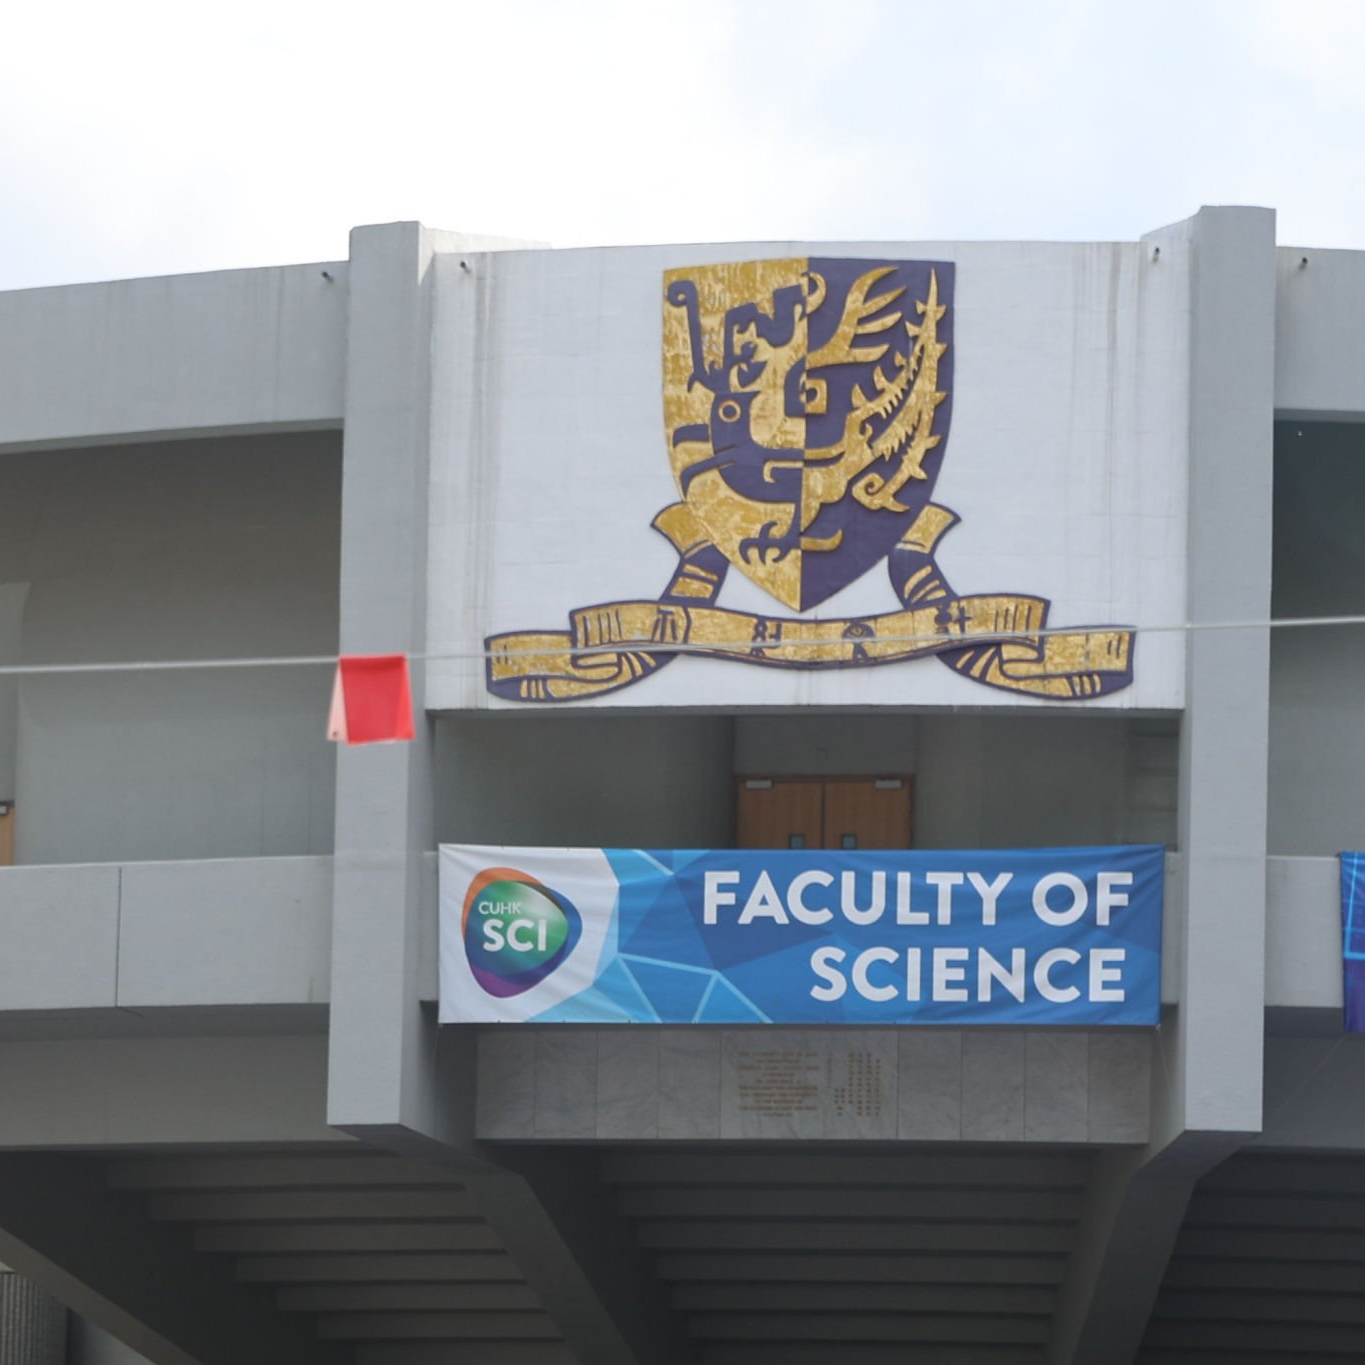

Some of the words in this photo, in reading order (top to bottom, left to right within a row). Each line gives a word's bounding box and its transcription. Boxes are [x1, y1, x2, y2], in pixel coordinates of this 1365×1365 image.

[478, 900, 522, 915] CUHK
[703, 869, 1014, 926] FACULTY
[1031, 871, 1134, 927] OF
[482, 918, 547, 953] SCI
[809, 945, 1127, 1003] SCIENCE
